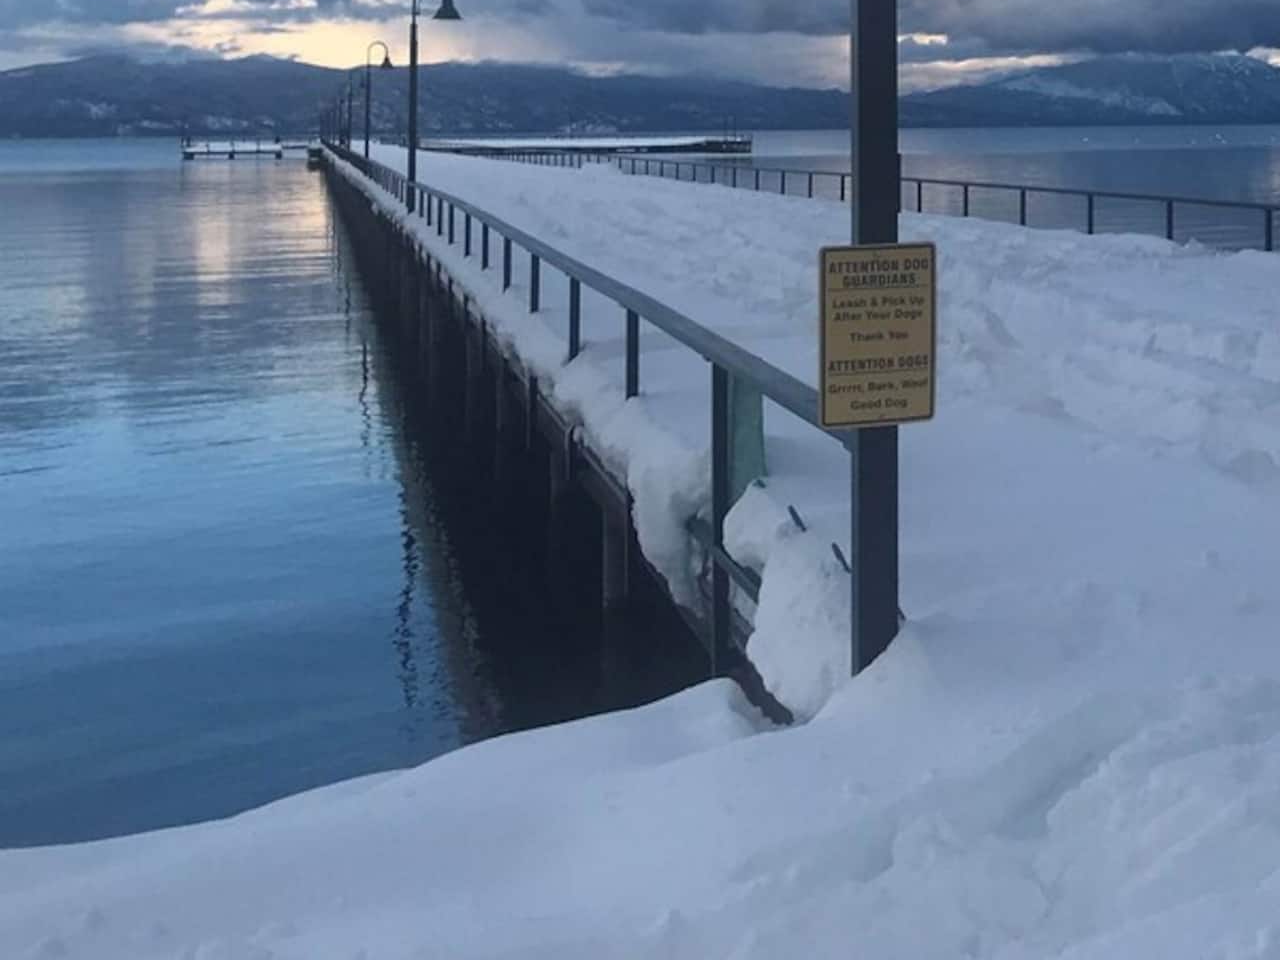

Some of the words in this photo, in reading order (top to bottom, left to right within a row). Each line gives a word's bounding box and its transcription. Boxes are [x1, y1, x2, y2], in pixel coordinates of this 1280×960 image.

[829, 261, 899, 273] ATTENTION
[903, 258, 929, 270] DOG
[842, 273, 915, 287] GUARDIANS
[832, 298, 866, 309] Leash
[881, 296, 905, 306] Pick
[833, 312, 861, 322] After
[865, 310, 893, 320] Your
[849, 332, 883, 342] Thank
[888, 331, 909, 339] You
[828, 359, 895, 371] ATTENTION
[897, 355, 928, 368] DOGS
[850, 399, 882, 410] Good
[885, 398, 908, 408] Dog
